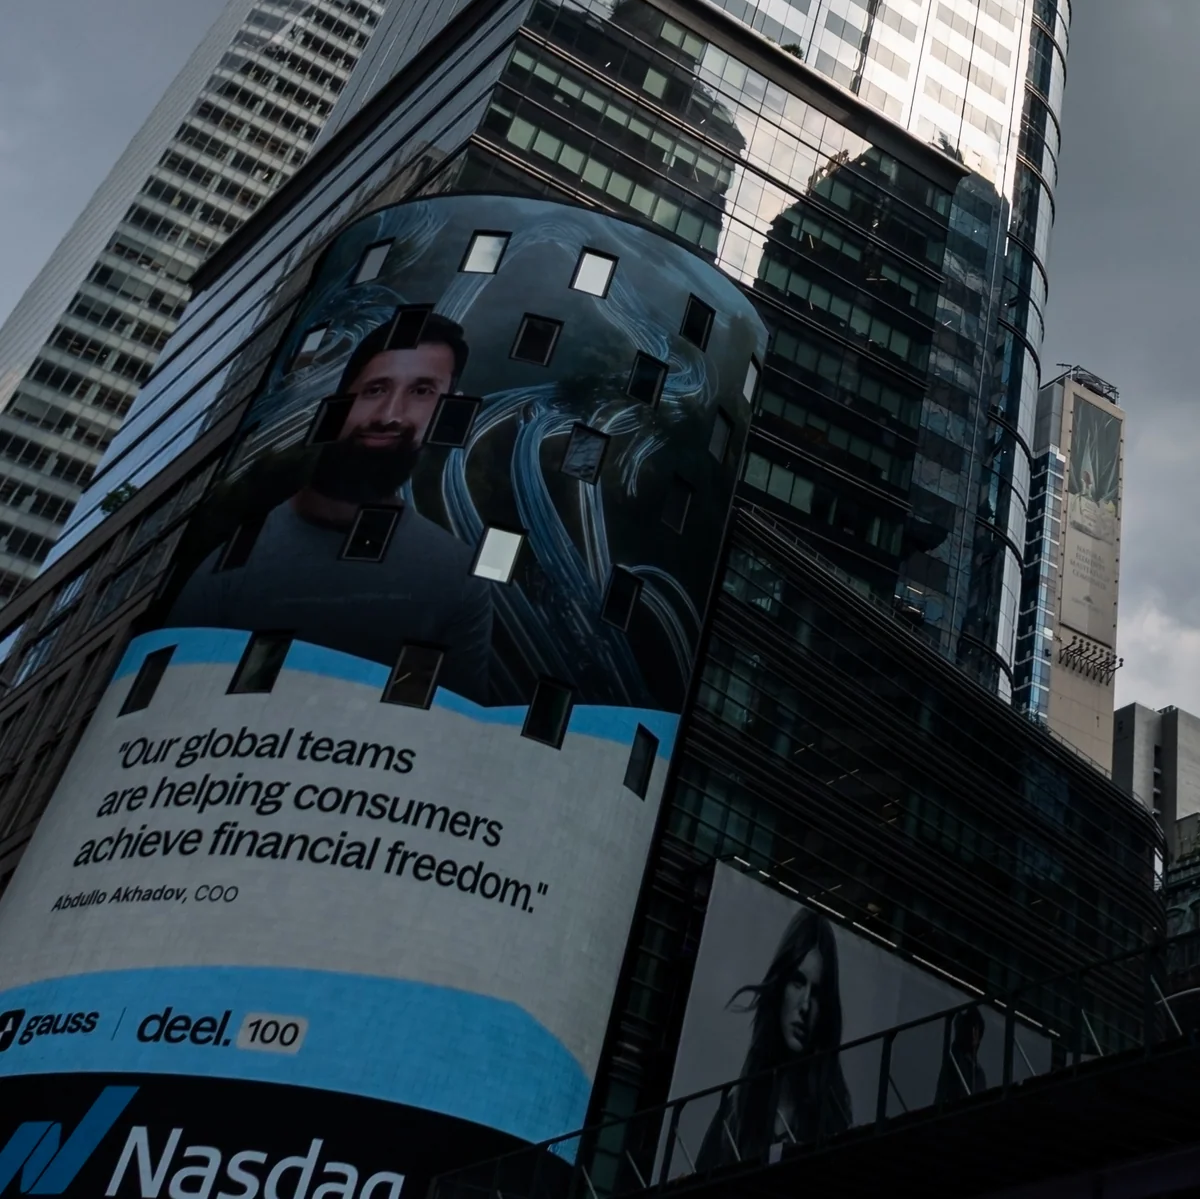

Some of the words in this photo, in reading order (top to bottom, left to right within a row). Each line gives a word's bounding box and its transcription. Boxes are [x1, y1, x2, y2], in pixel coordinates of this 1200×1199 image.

[119, 736, 182, 769] "Our
[175, 727, 294, 768] global
[297, 731, 416, 774] teams
[97, 785, 148, 818] are
[150, 773, 291, 817] helping
[293, 784, 504, 847] consumers
[73, 823, 203, 868] achieve
[208, 821, 382, 871] financial
[384, 840, 549, 914] freedom."
[51, 888, 107, 912] Abdullo
[108, 885, 188, 904] Akhadov,
[194, 885, 239, 903] COO
[18, 1011, 100, 1046] gauss
[137, 1007, 233, 1046] deel.
[248, 1019, 300, 1047] 100
